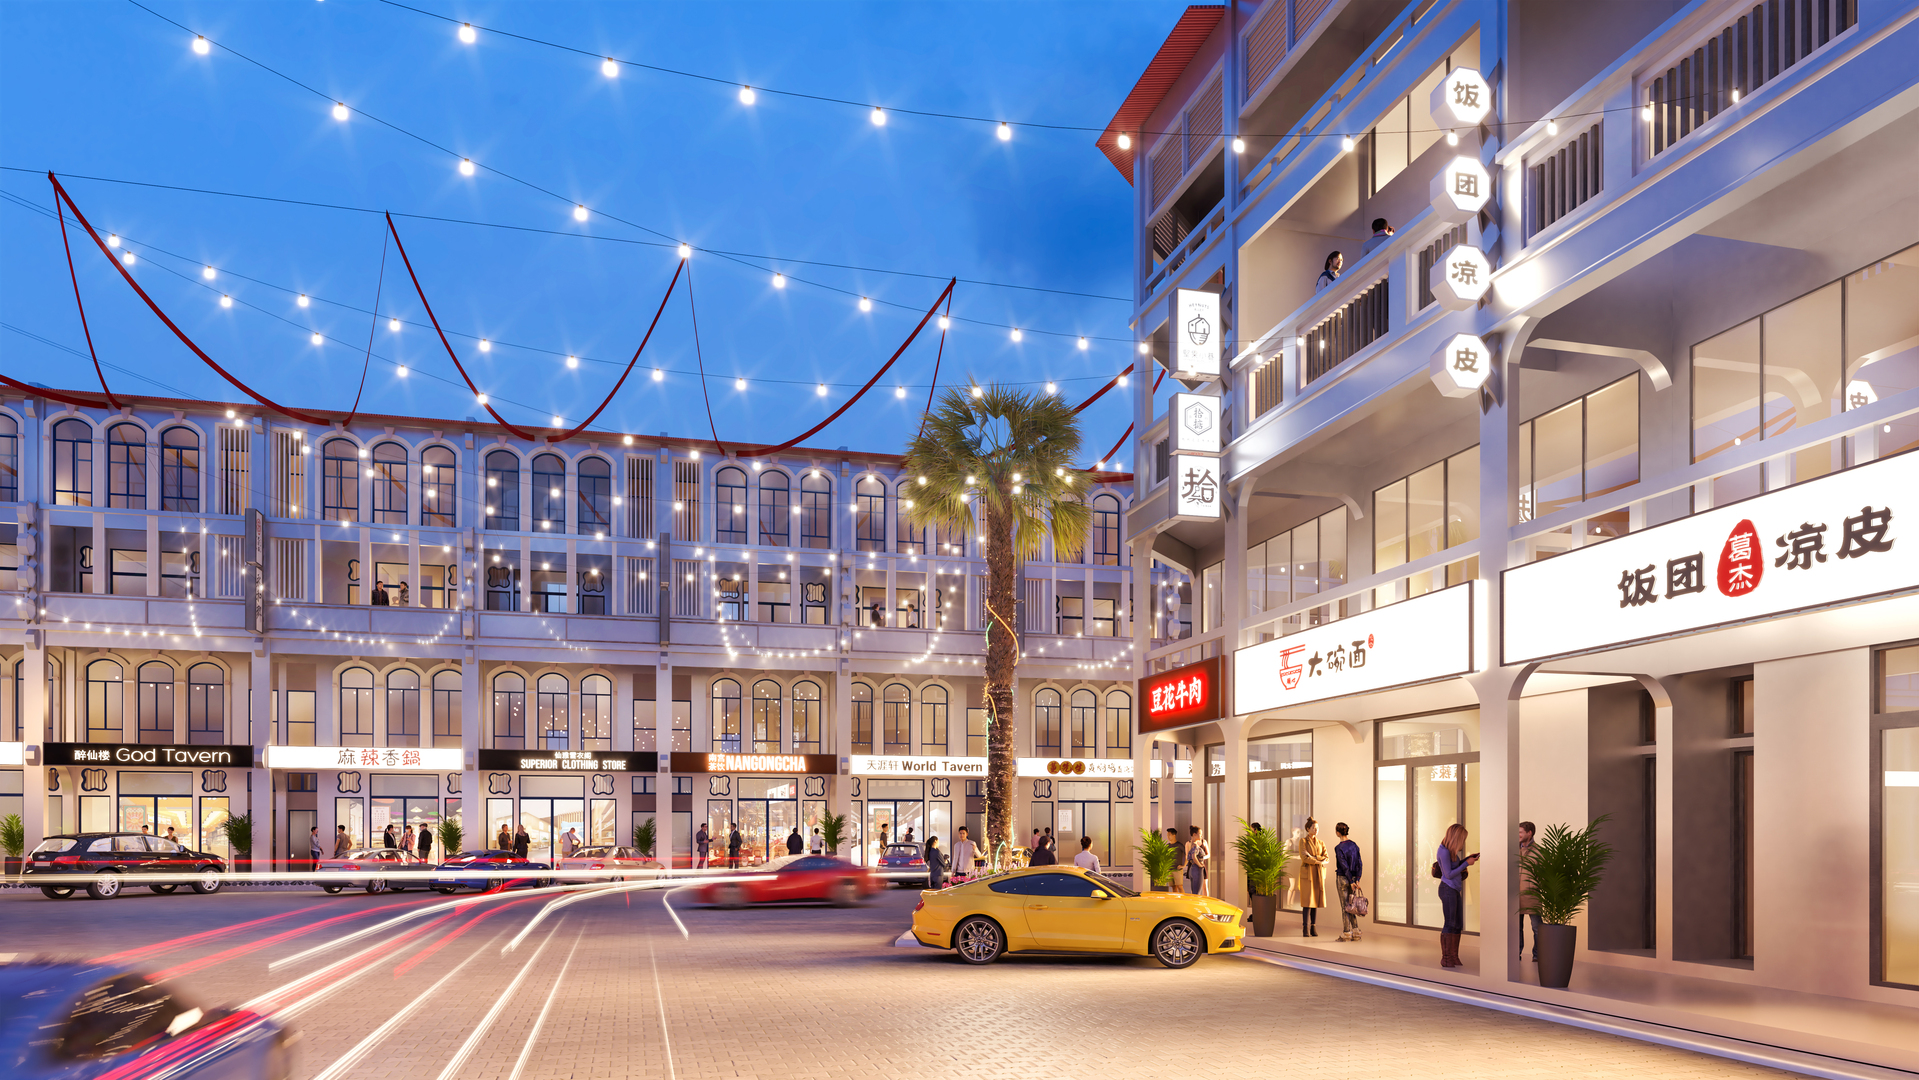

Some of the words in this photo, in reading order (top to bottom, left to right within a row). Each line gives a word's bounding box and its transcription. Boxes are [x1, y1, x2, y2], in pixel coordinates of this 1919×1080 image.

[1452, 81, 1480, 374] 饭团凉皮
[1617, 551, 1706, 608] 饭团
[1775, 506, 1895, 571] 凉皮
[1728, 532, 1753, 593] 葛杰
[1308, 640, 1366, 678] 大碗面
[1151, 676, 1201, 712] 豆花牛肉
[74, 749, 110, 761] 醉仙楼
[116, 748, 156, 762] God
[162, 748, 231, 763] Tavern
[726, 755, 806, 772] NANGONGCHA
[520, 759, 558, 769] SUPERIOR
[562, 760, 598, 770] CLOTHING
[602, 760, 627, 770] STORE
[866, 760, 899, 771] 天涯轩
[902, 761, 937, 772] World
[942, 761, 983, 772] Tavern
